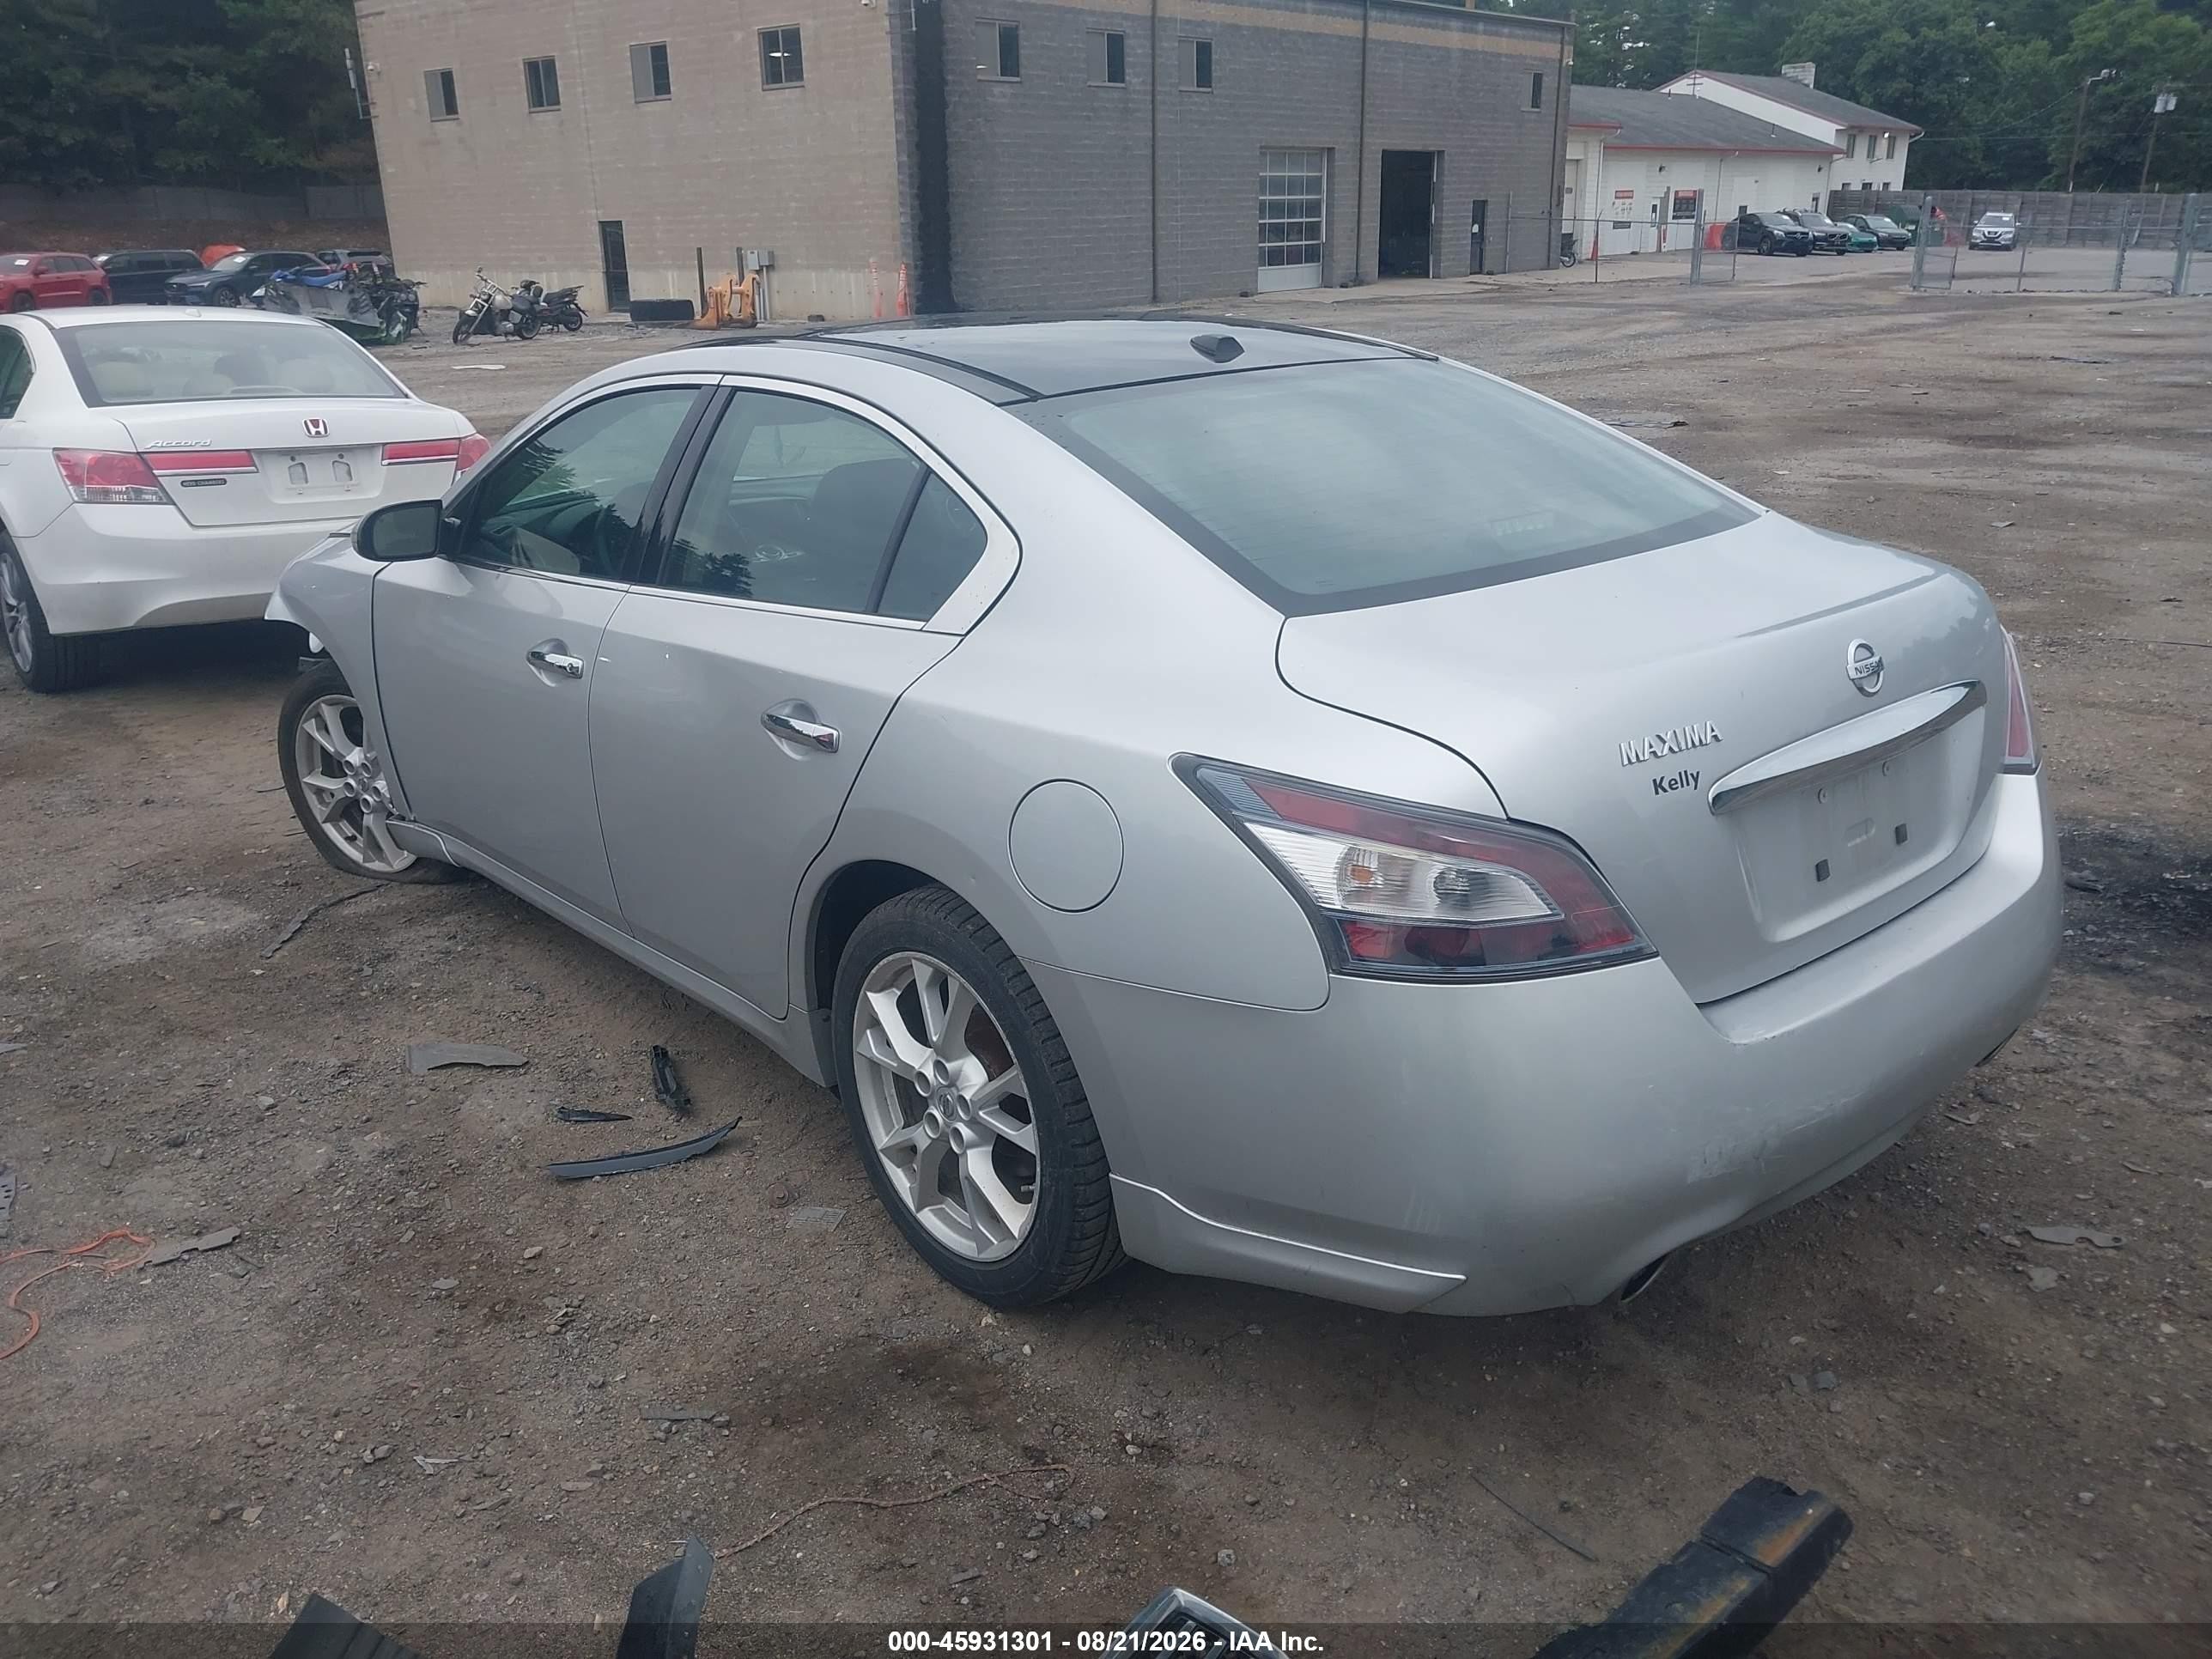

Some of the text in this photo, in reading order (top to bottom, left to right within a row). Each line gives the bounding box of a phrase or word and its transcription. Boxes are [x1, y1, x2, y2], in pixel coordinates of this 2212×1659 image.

[143, 439, 213, 450] Accord
[1619, 720, 1723, 767] MAXIMA
[1651, 769, 1700, 796] Kelly
